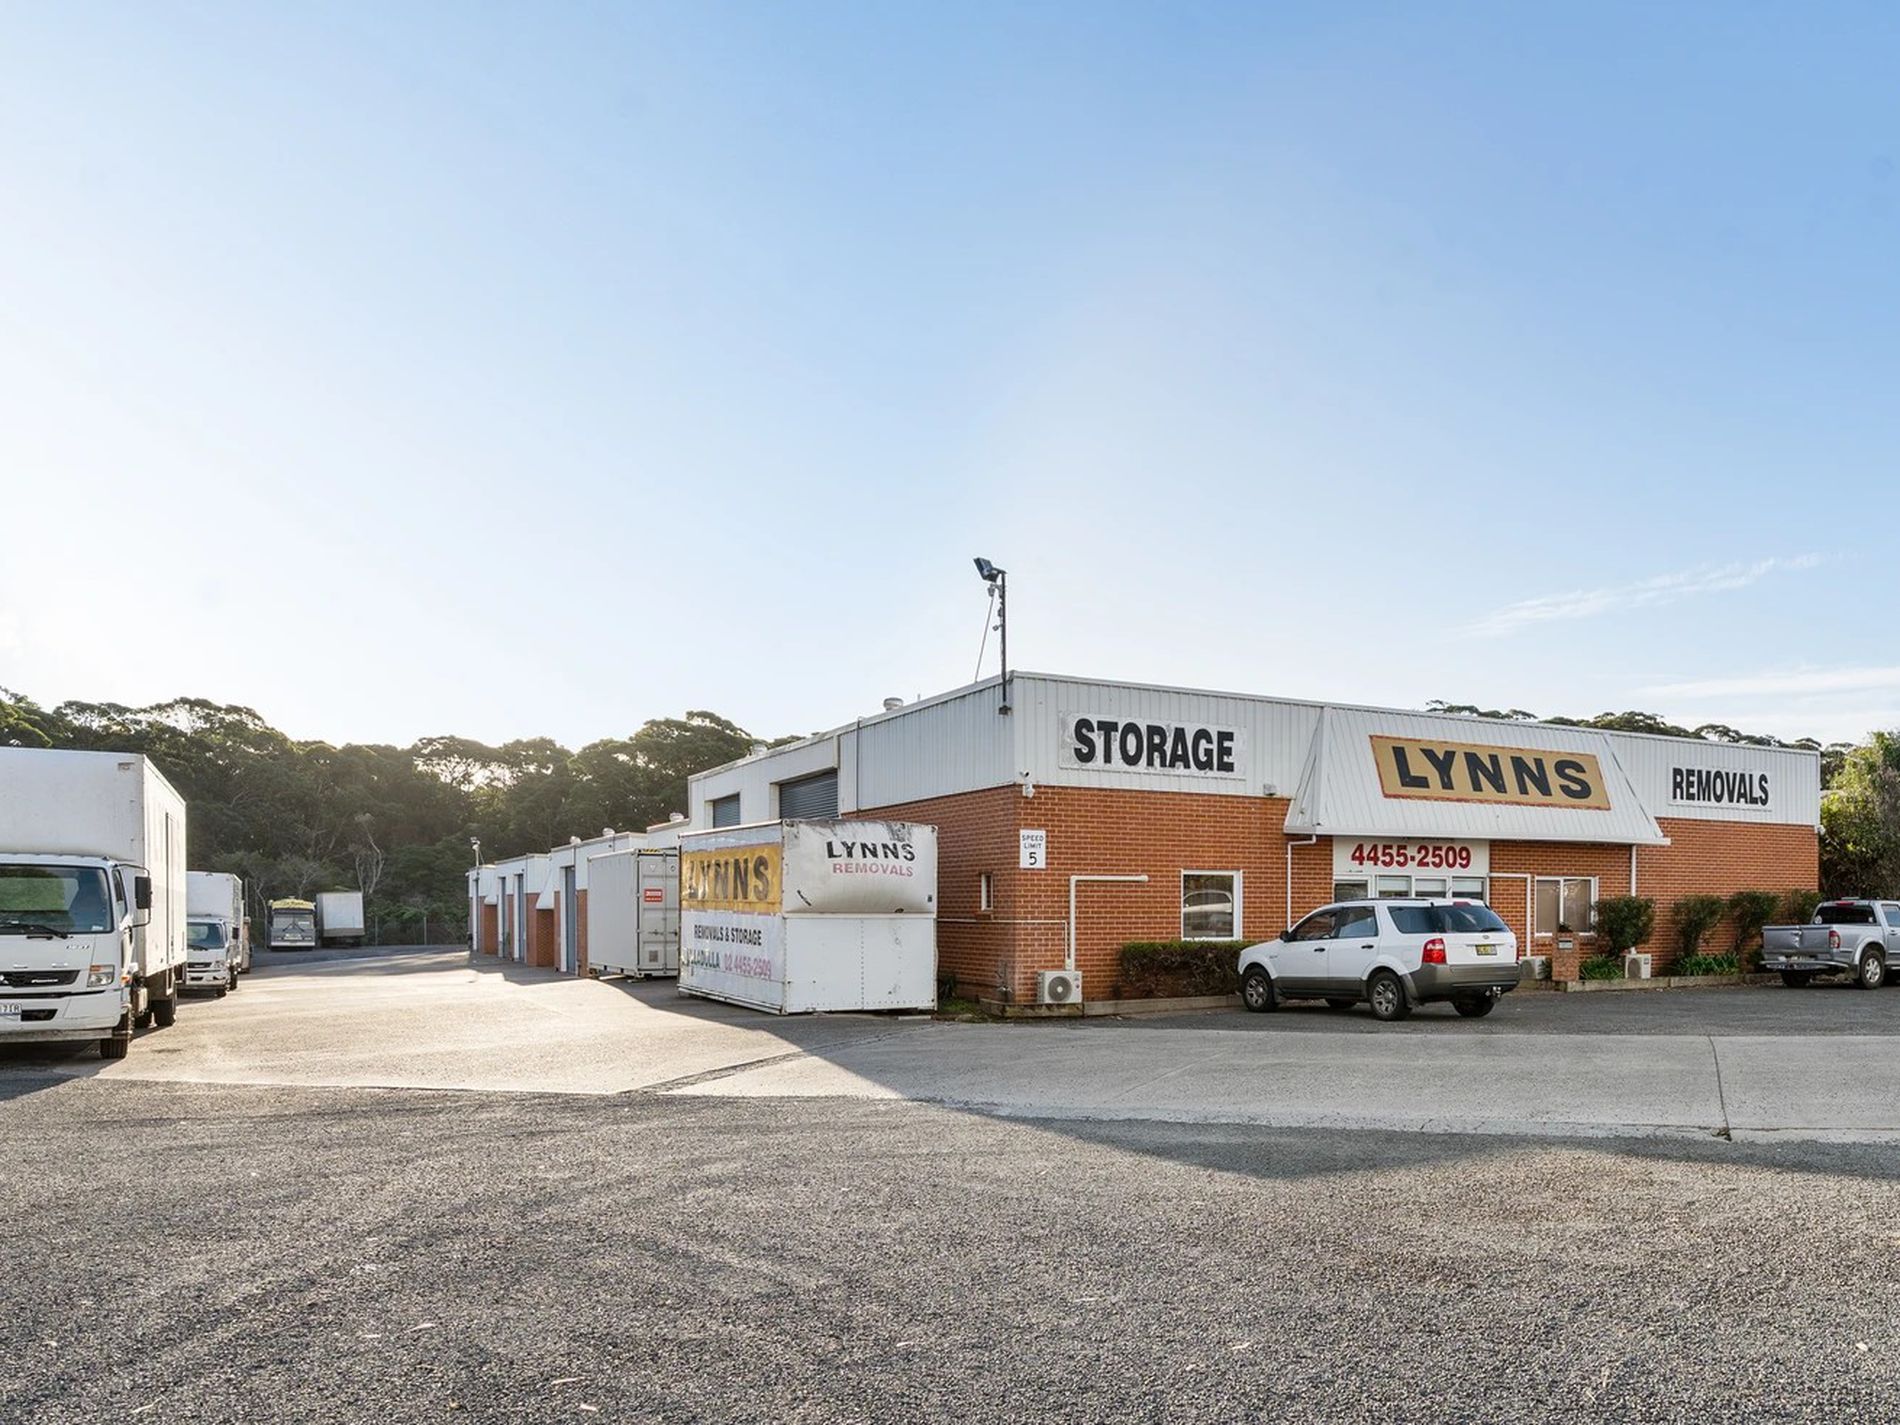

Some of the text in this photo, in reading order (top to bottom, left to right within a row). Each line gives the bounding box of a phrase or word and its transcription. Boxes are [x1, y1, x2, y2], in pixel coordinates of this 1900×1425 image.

[1074, 718, 1235, 772] STORAGE
[1391, 745, 1592, 800] LYNNS
[1672, 767, 1769, 806] REMOVALS
[1021, 834, 1044, 842] SPEED
[826, 840, 916, 862] LYNNS
[1029, 851, 1038, 866] 5
[1351, 843, 1471, 869] 4455-2509
[687, 855, 770, 901] LYNNS
[832, 862, 915, 878] REMOVALS
[693, 924, 762, 947] REMOVALS & STORAGE
